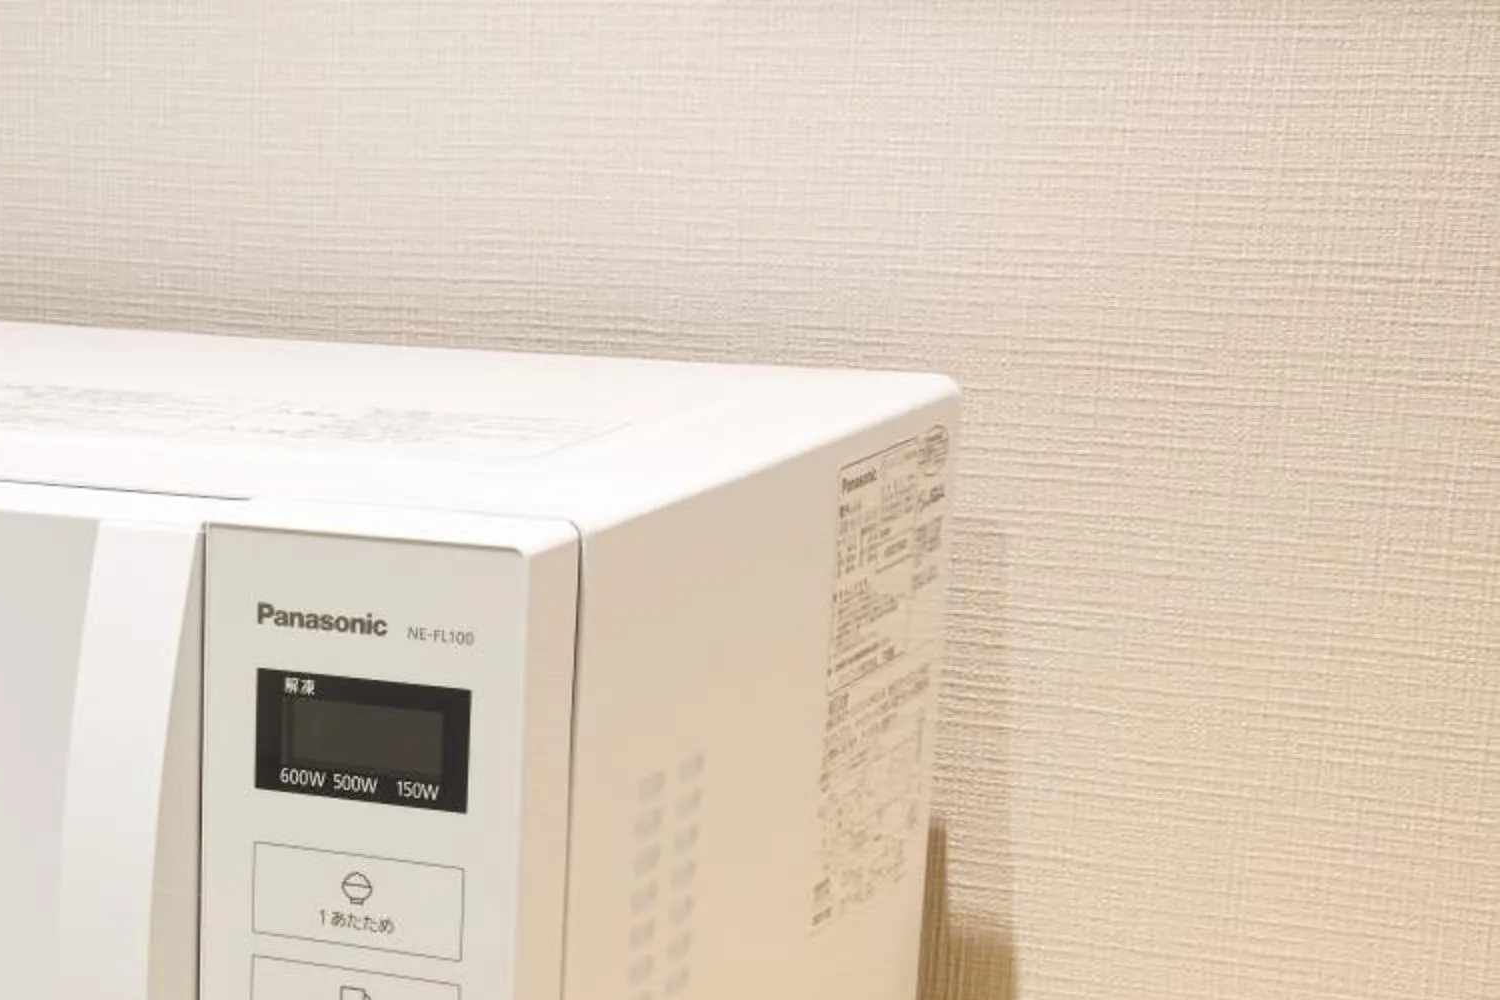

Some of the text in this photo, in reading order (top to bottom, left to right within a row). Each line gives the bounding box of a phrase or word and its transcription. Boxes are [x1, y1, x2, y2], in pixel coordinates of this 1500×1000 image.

[257, 602, 475, 646] Panasonic NE-FL100
[284, 677, 316, 696] 解凍
[279, 767, 440, 800] 600W 500W 150W
